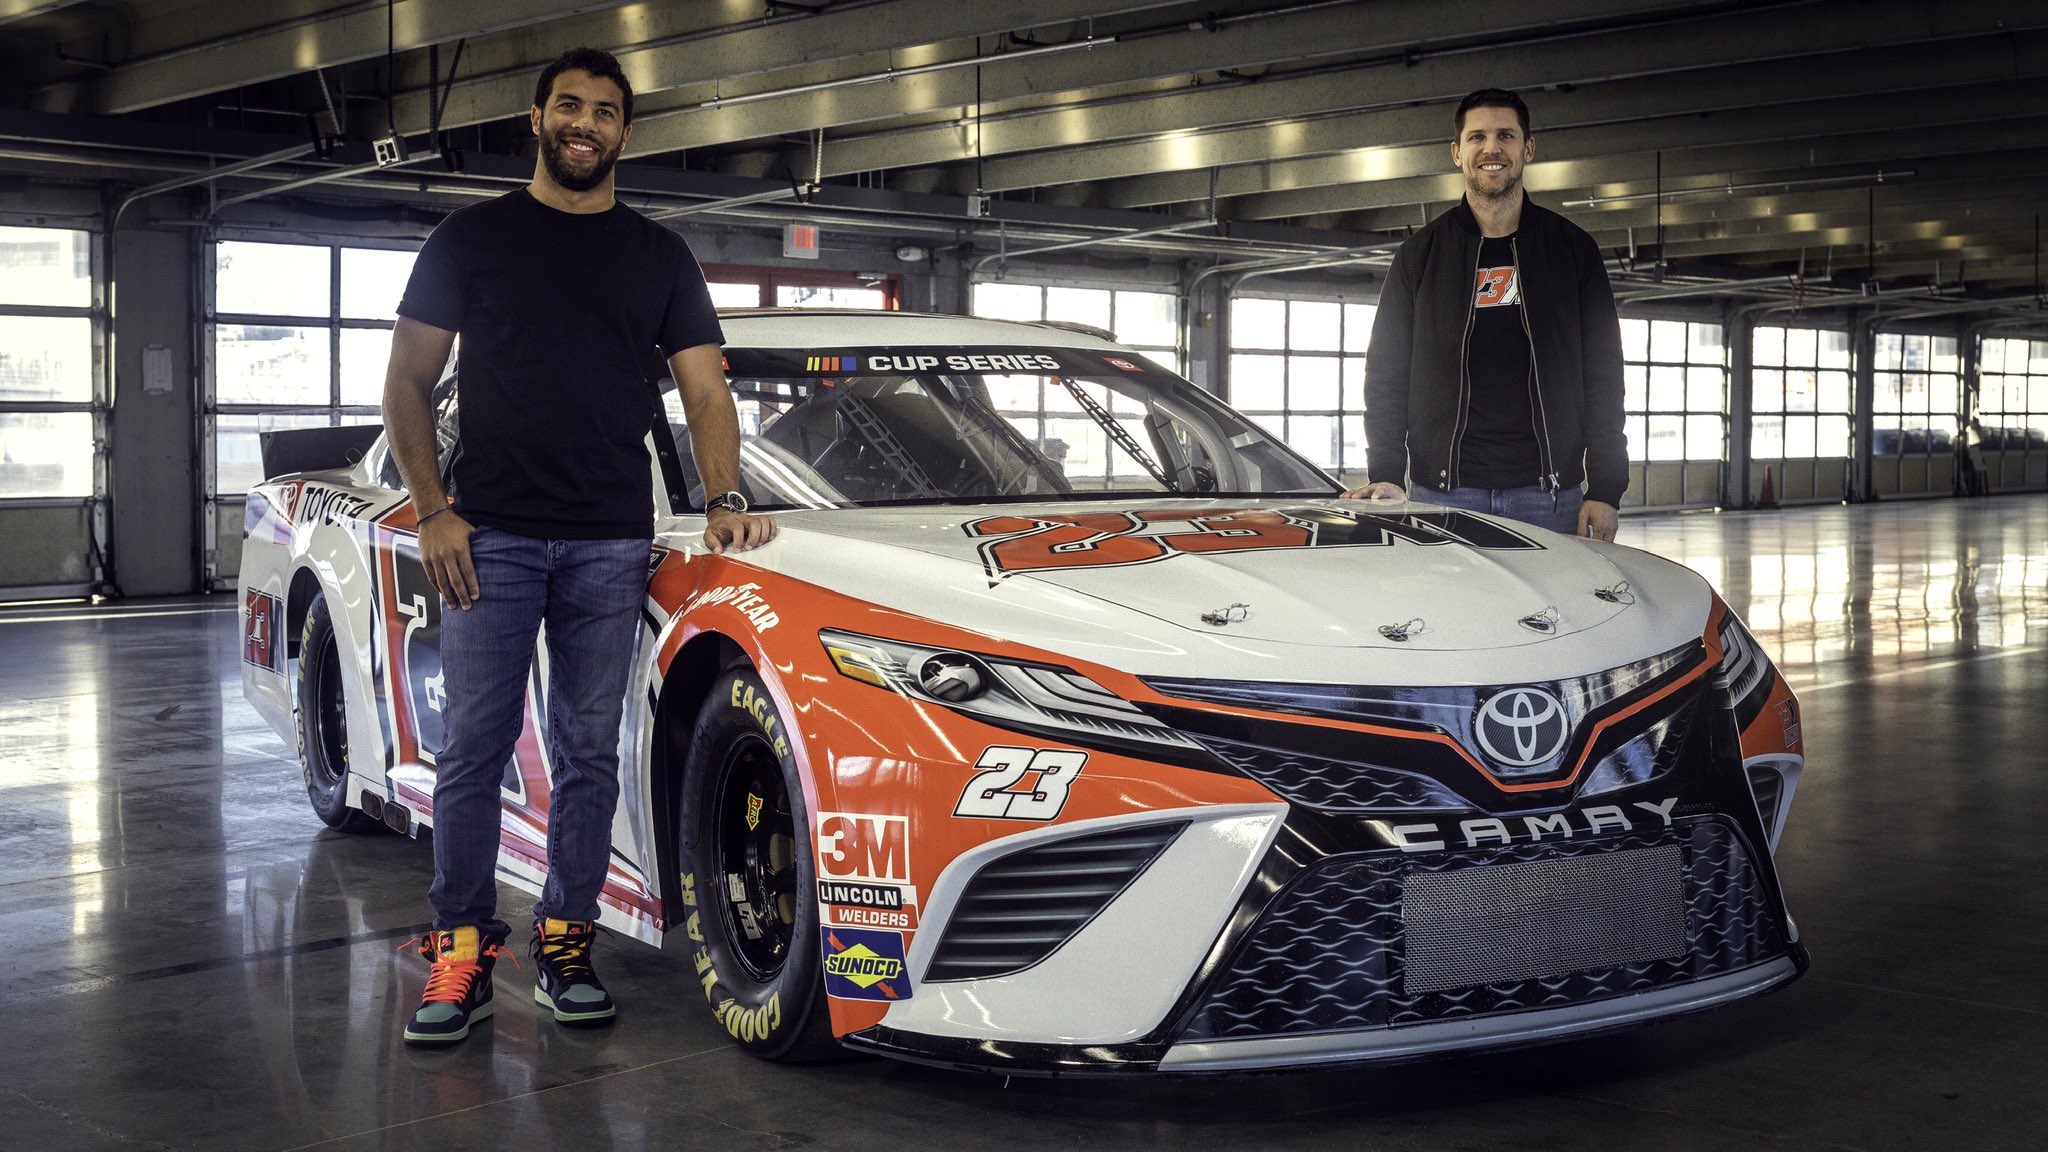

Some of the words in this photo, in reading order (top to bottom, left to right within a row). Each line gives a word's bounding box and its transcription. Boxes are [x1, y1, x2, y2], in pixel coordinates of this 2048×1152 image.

[793, 227, 815, 250] EXIT
[868, 356, 939, 371] CUP
[945, 355, 1061, 371] SERIES
[301, 487, 375, 530] TOYOTA
[731, 679, 789, 764] EAGLE
[951, 745, 1089, 822] 23
[1393, 797, 1679, 853] CAMRY
[820, 816, 906, 880] 3M
[820, 885, 898, 906] LINCOLN
[838, 908, 909, 927] WELDERS
[681, 872, 781, 1043] GOODYEAR
[827, 955, 901, 977] SUNOCO
